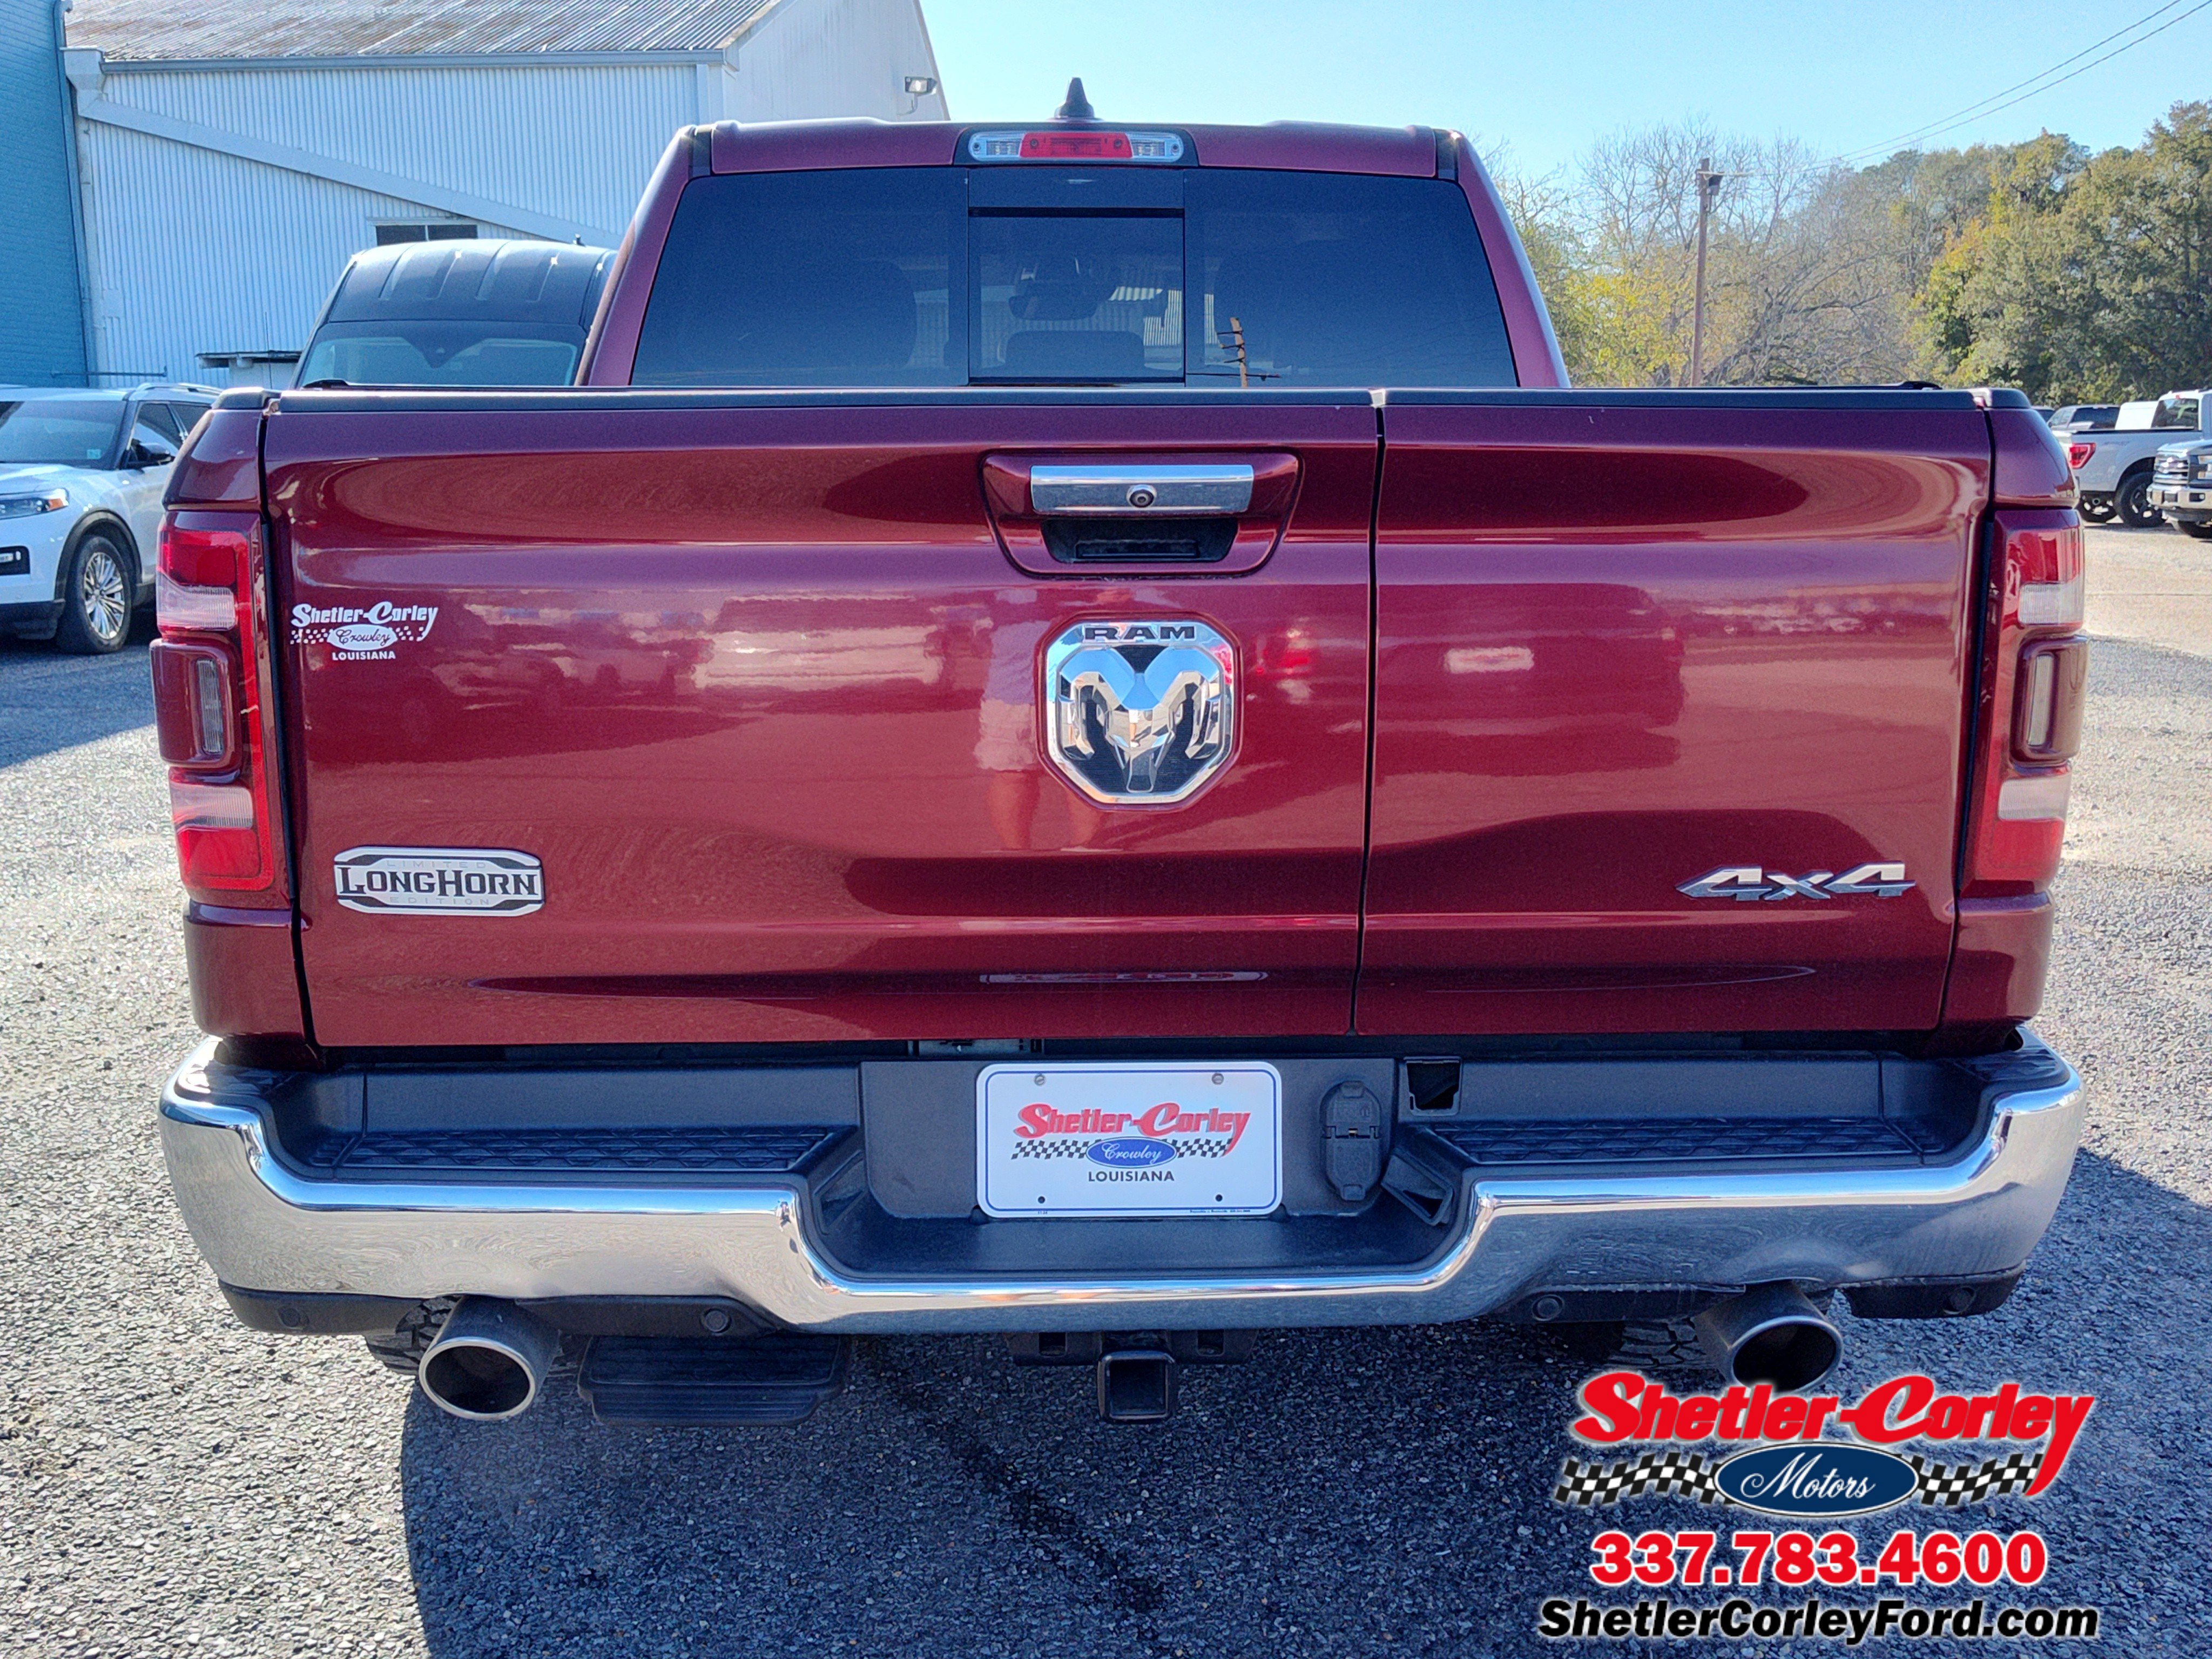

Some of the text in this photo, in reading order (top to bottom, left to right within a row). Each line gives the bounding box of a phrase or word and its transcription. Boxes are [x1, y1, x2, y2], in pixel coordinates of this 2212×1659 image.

[291, 601, 439, 642] Shetler-Corley
[336, 629, 392, 646] Crowley
[1084, 625, 1195, 640] RAM
[332, 651, 396, 661] LOUISIANA
[386, 860, 486, 868] LIMITED
[389, 896, 489, 905] EDITION
[1014, 1102, 1251, 1156] Shetler-Corley
[1101, 1142, 1162, 1165] Crowley
[1088, 1170, 1175, 1182] LOUISIANA
